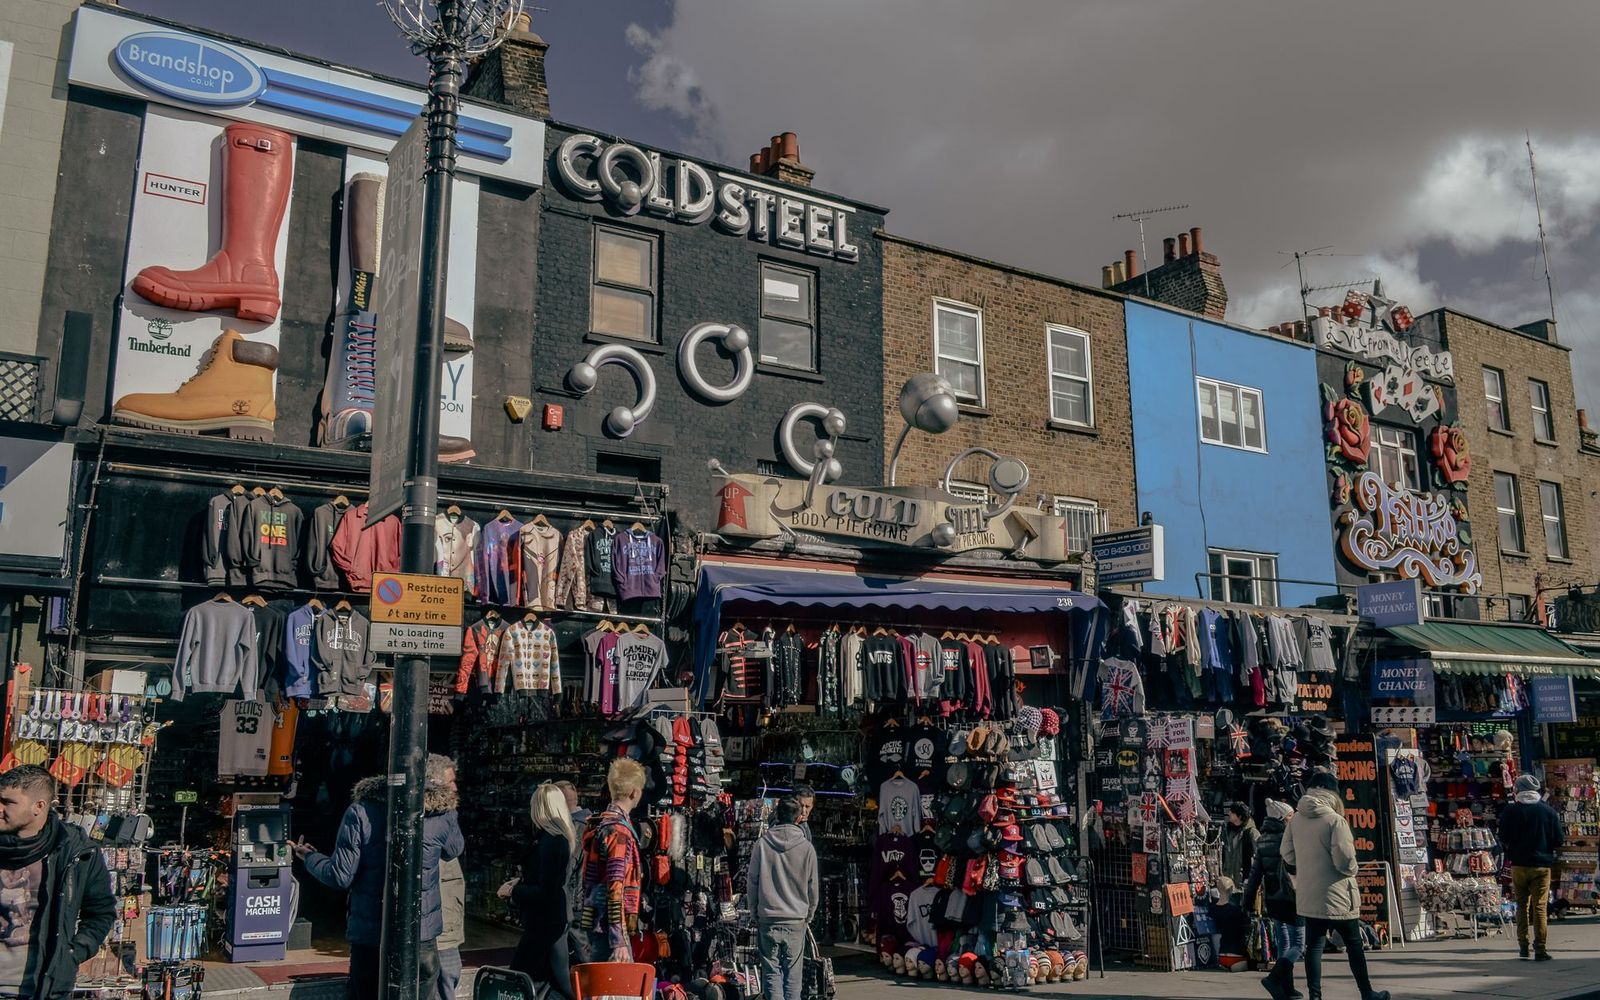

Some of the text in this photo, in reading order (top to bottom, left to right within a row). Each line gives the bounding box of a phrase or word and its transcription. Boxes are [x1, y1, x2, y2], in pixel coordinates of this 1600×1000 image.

[129, 44, 234, 94] Brandshop
[188, 76, 214, 88] .co.uk
[557, 133, 715, 215] COLD
[150, 181, 200, 197] HUNTER
[719, 182, 859, 262] STEEL
[127, 336, 191, 357] Timberland
[1368, 337, 1390, 353] from
[724, 488, 739, 499] UP
[827, 488, 920, 527] COLD
[260, 511, 288, 524] KEEP
[260, 524, 287, 538] ONE
[792, 511, 909, 542] BODY PIERCING
[963, 532, 996, 548] PIERCING
[1094, 542, 1150, 557] 020 8450 1000
[407, 583, 459, 594] Restricted
[420, 594, 445, 604] Zone
[1056, 597, 1073, 607] 238
[1369, 591, 1405, 603] MONEY
[1361, 602, 1415, 615] EXCHANGE
[403, 611, 421, 620] any
[389, 628, 444, 639] No loading
[387, 640, 445, 650] at any time
[623, 645, 658, 660] CAMDEN
[626, 653, 654, 664] TOWN
[1381, 668, 1423, 678] MONEY
[1500, 663, 1553, 674] NEW YORK
[1297, 684, 1332, 698] TATTOO
[1378, 680, 1426, 691] CHANGE
[235, 701, 263, 717] CELTICS
[1302, 700, 1328, 711] Studio
[236, 716, 258, 734] 33
[1334, 741, 1373, 752] amden
[1336, 760, 1376, 781] ERCING
[1345, 788, 1355, 800] &
[1345, 808, 1377, 829] TTOO
[1357, 876, 1385, 887] ERCING
[246, 895, 281, 908] CASH
[1361, 894, 1384, 904] TTOO
[245, 907, 281, 916] MACHINE
